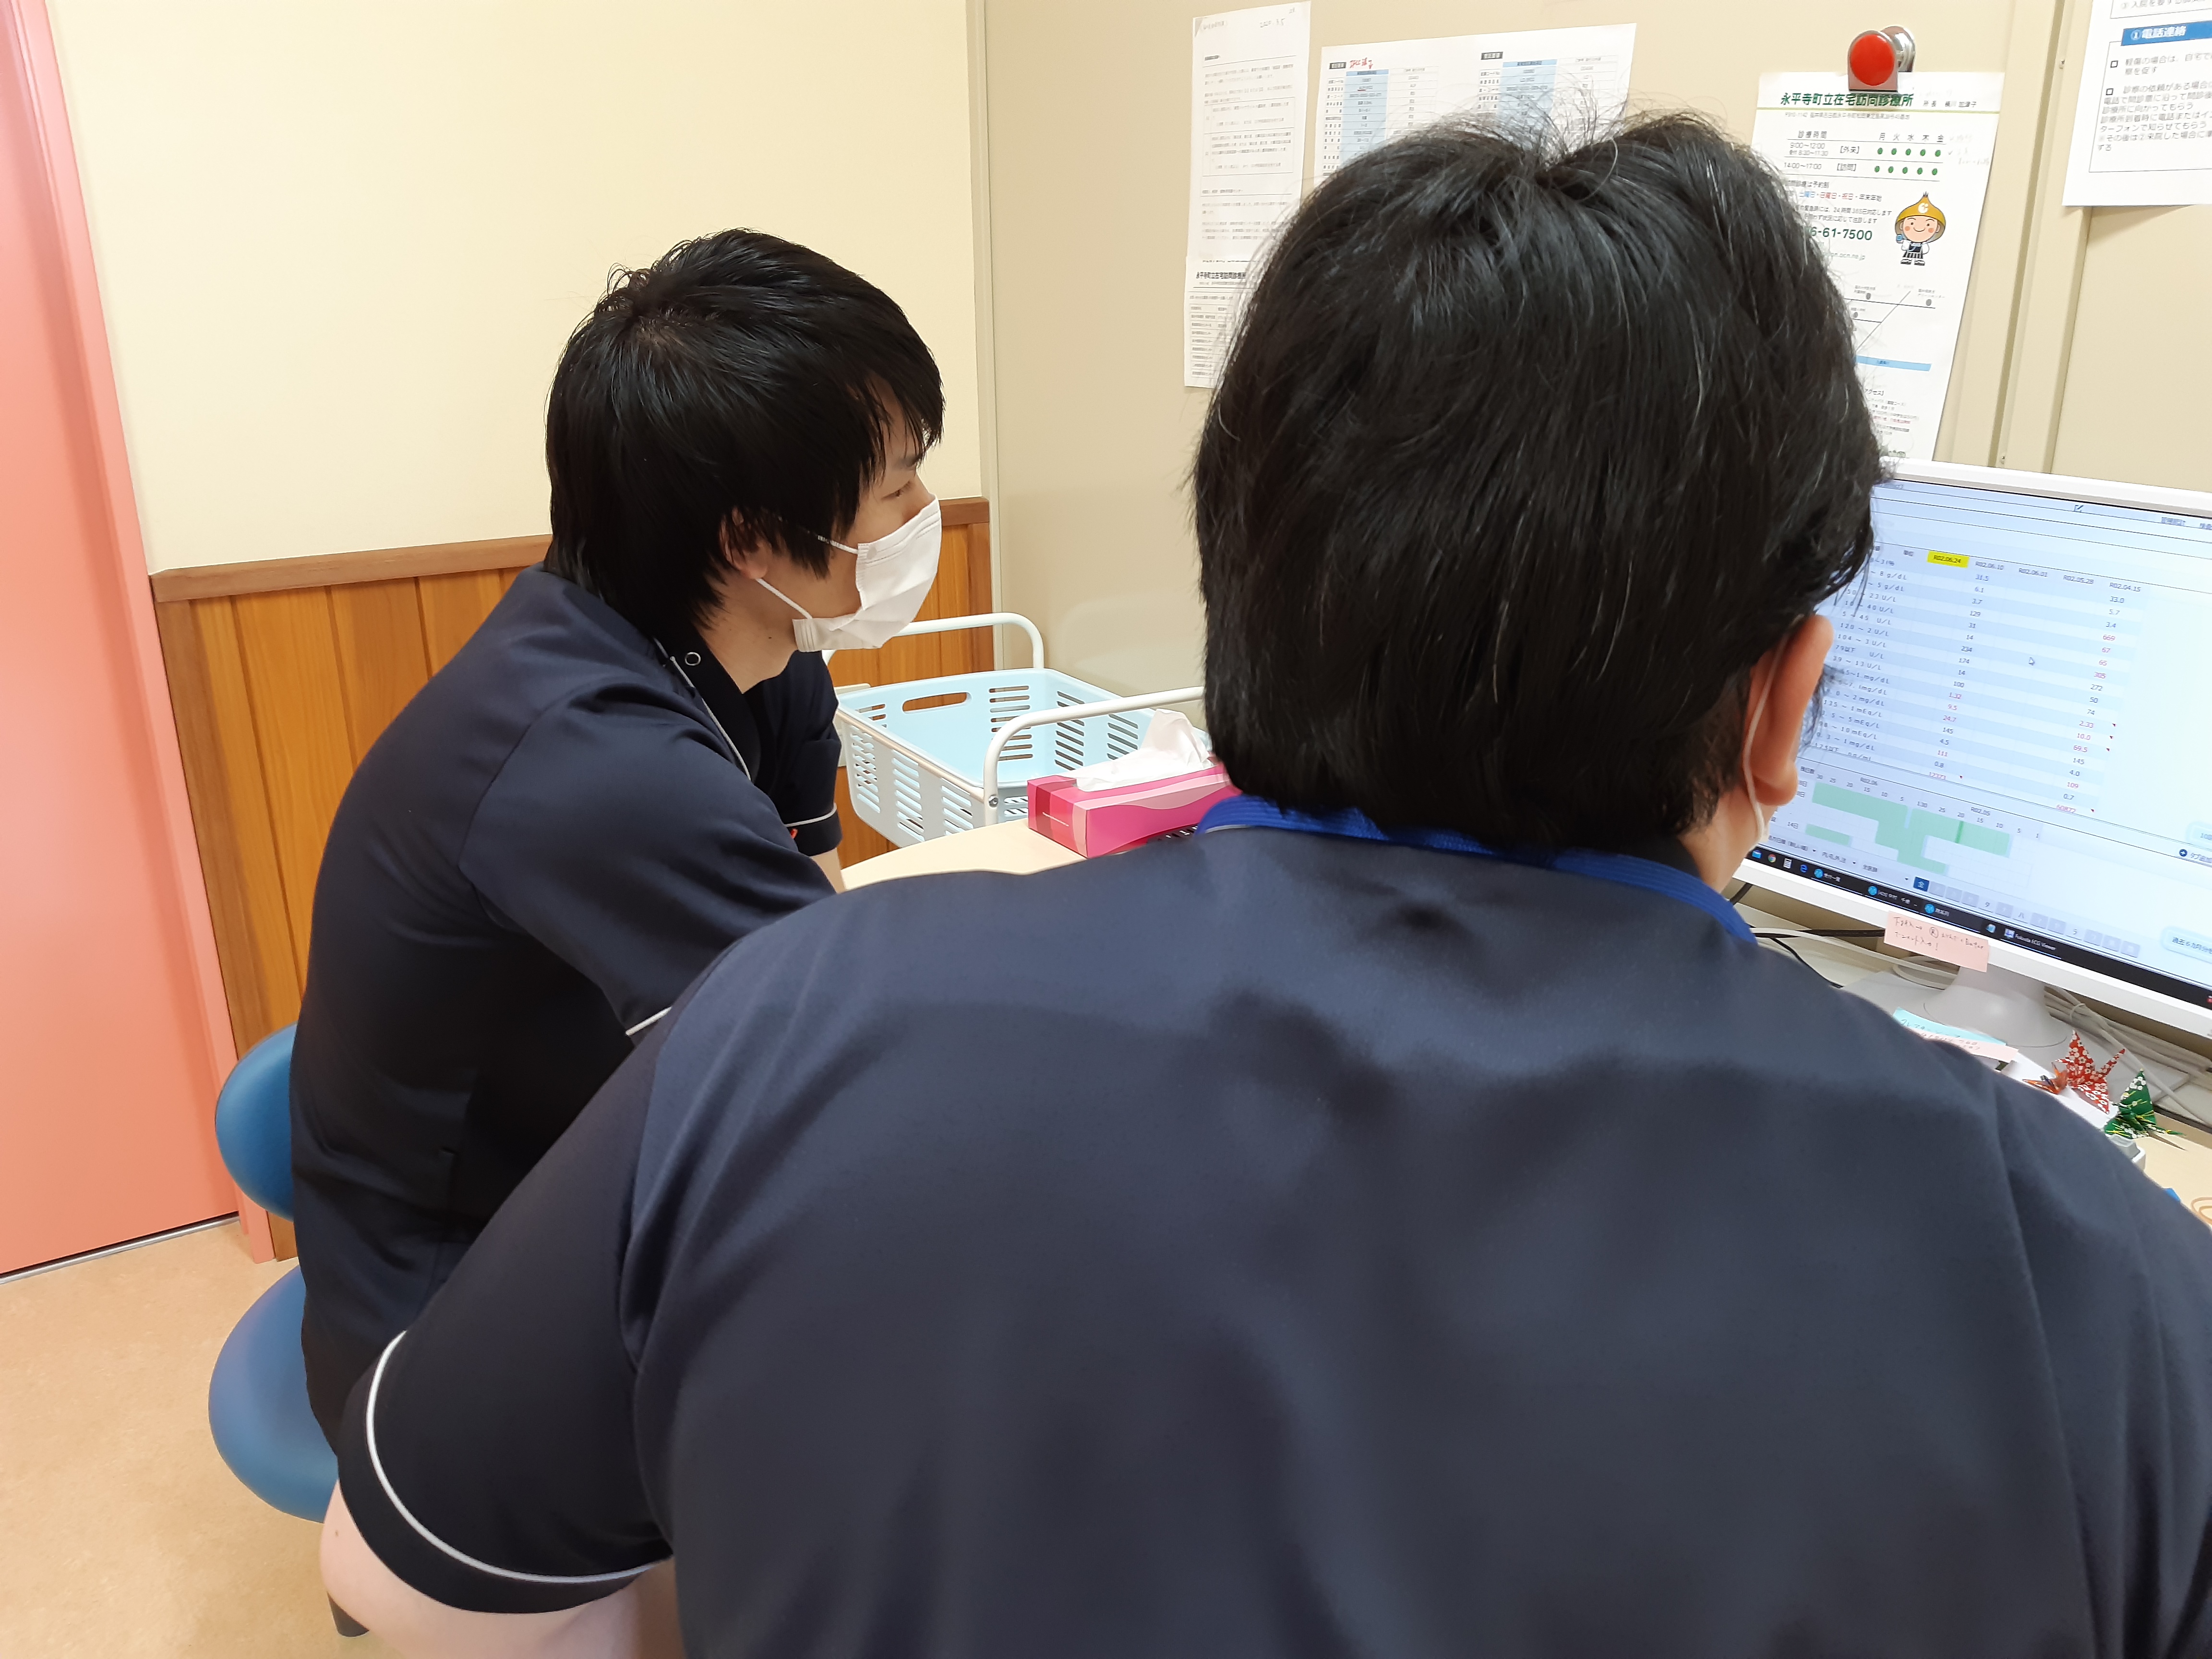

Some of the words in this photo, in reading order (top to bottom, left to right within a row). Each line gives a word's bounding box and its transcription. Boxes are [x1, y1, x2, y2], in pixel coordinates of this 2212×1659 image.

[1780, 93, 1914, 106] 永平寺町立在宅訪問診療所
